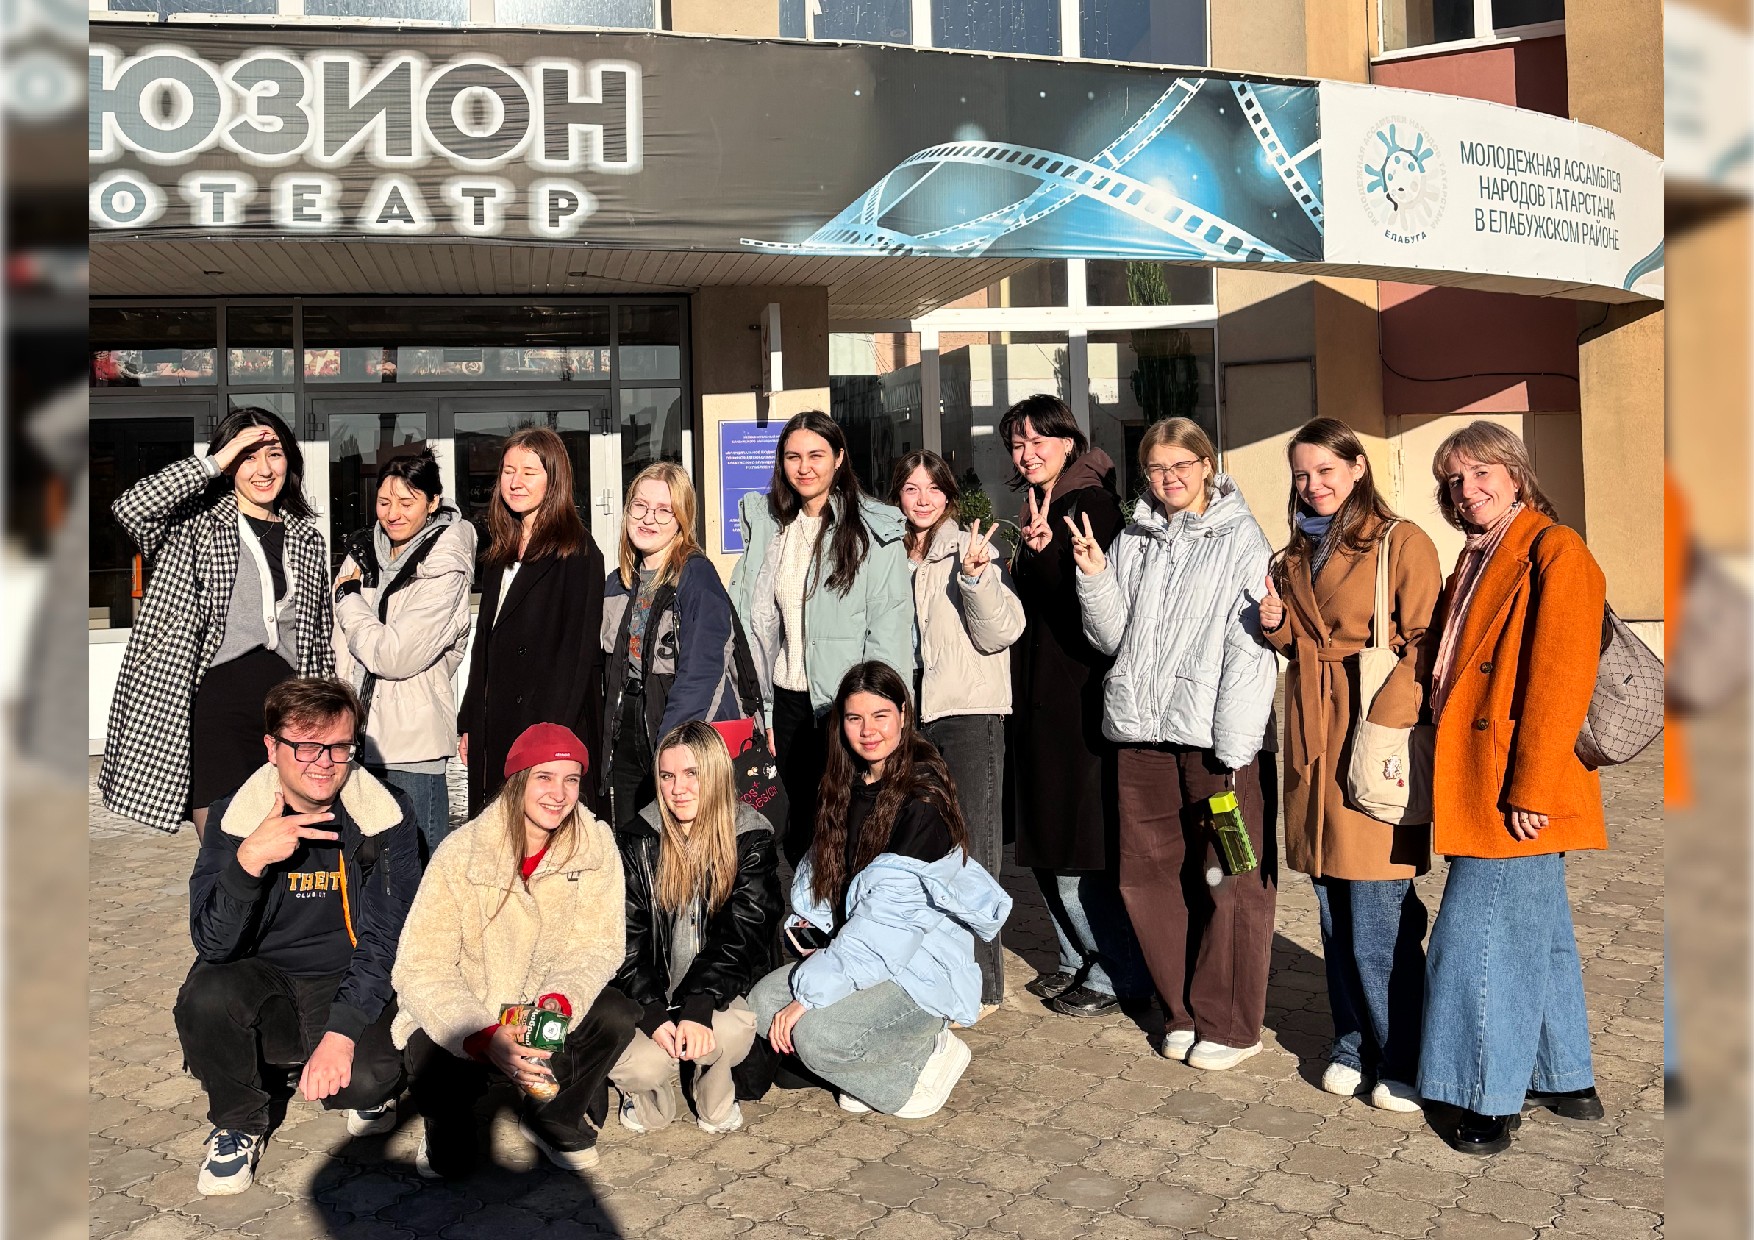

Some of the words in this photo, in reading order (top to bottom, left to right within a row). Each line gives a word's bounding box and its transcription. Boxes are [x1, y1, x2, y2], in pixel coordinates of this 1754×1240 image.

[1460, 140, 1560, 179] МОЛОДЕЖНАЯ
[1563, 158, 1622, 193] АССАМБЛЕЯ
[99, 179, 582, 229] ОТЕАТР
[1479, 174, 1545, 210] НАРОДОВ
[1547, 186, 1616, 220] ТАТАРСТАНА
[1384, 229, 1427, 244] ЕЛАБУГА
[1475, 207, 1486, 232] В
[1489, 208, 1580, 243] ЕЛАБУЖСКОМ
[1581, 219, 1620, 251] РАЙОНЕ
